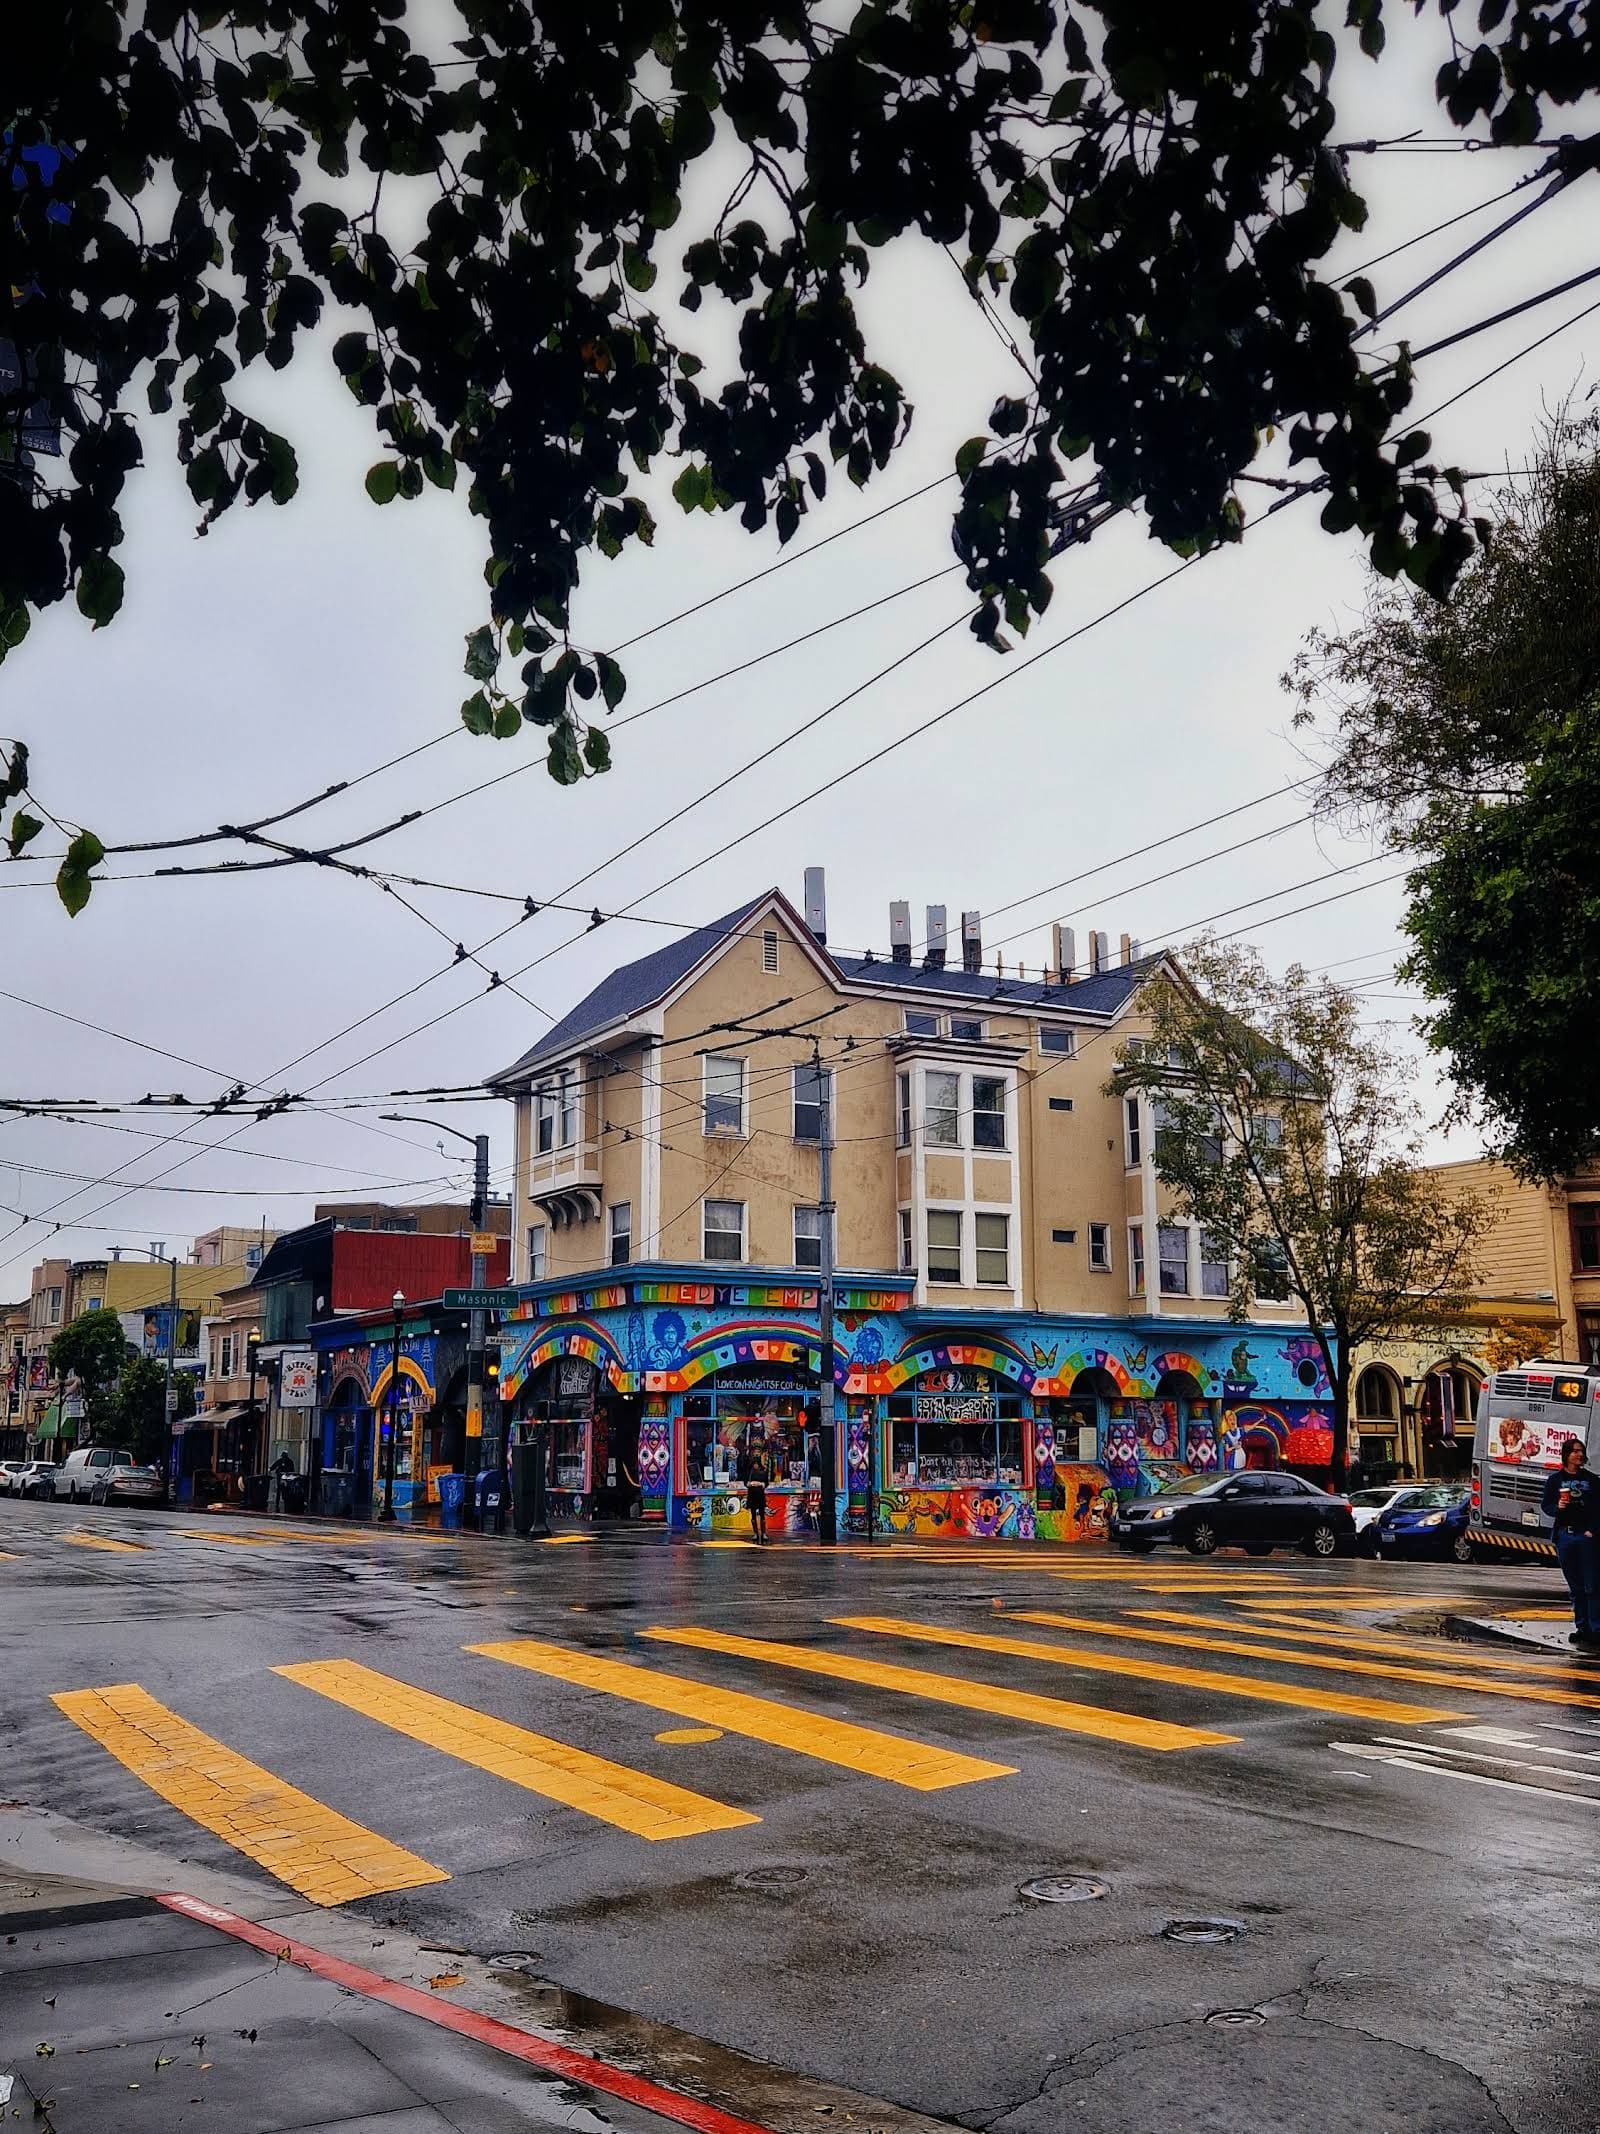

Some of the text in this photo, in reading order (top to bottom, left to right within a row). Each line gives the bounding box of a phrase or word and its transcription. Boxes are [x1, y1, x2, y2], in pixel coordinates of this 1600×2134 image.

[457, 1293, 506, 1305] Masonic
[766, 1287, 896, 1308] EMPRIUM
[144, 1347, 200, 1358] PLAYOUSE
[1371, 1343, 1409, 1359] ROSE
[918, 1398, 995, 1424] HAIGHT
[1547, 1427, 1578, 1441] Panto
